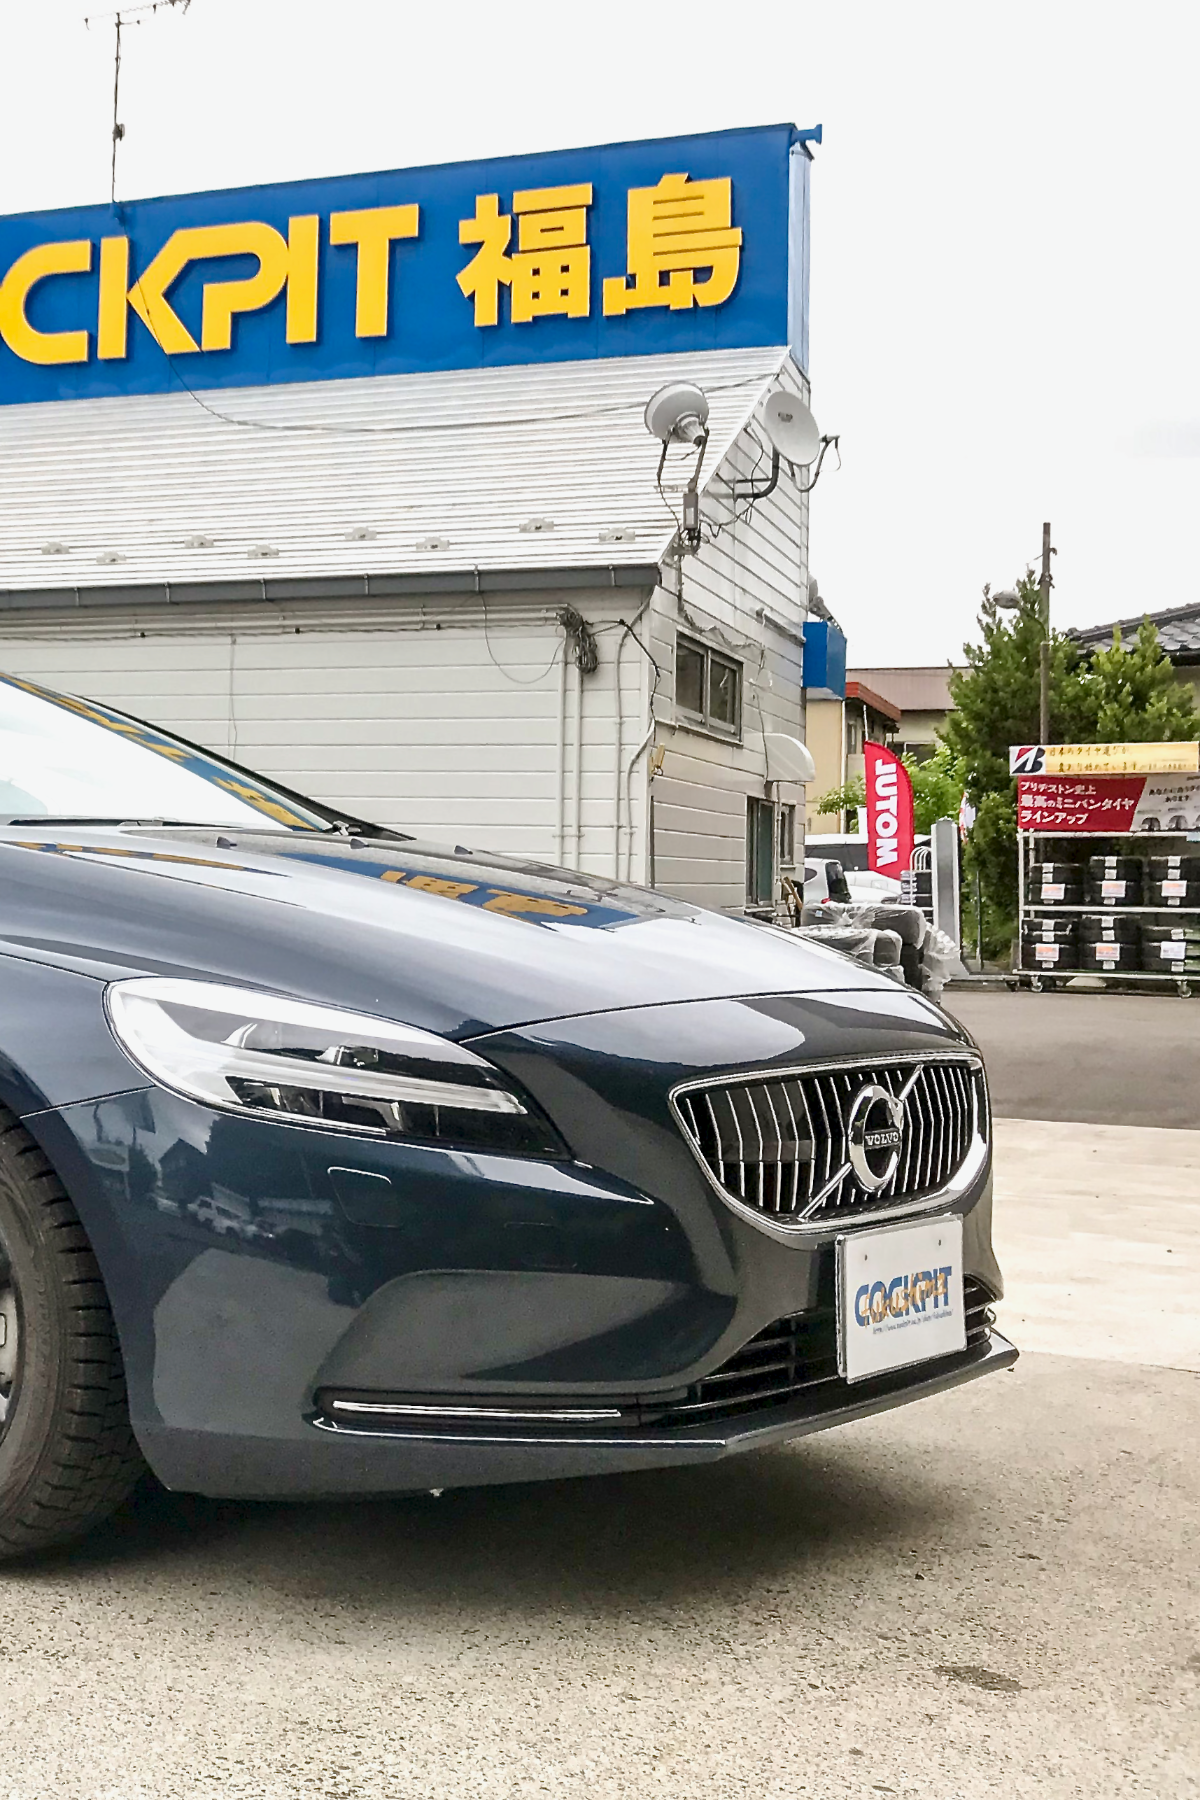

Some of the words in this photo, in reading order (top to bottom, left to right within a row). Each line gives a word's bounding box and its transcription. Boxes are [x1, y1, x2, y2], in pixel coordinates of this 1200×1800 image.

[456, 173, 743, 327] 福島
[865, 1131, 899, 1146] VOLVO
[854, 1265, 952, 1327] COCKPIT
